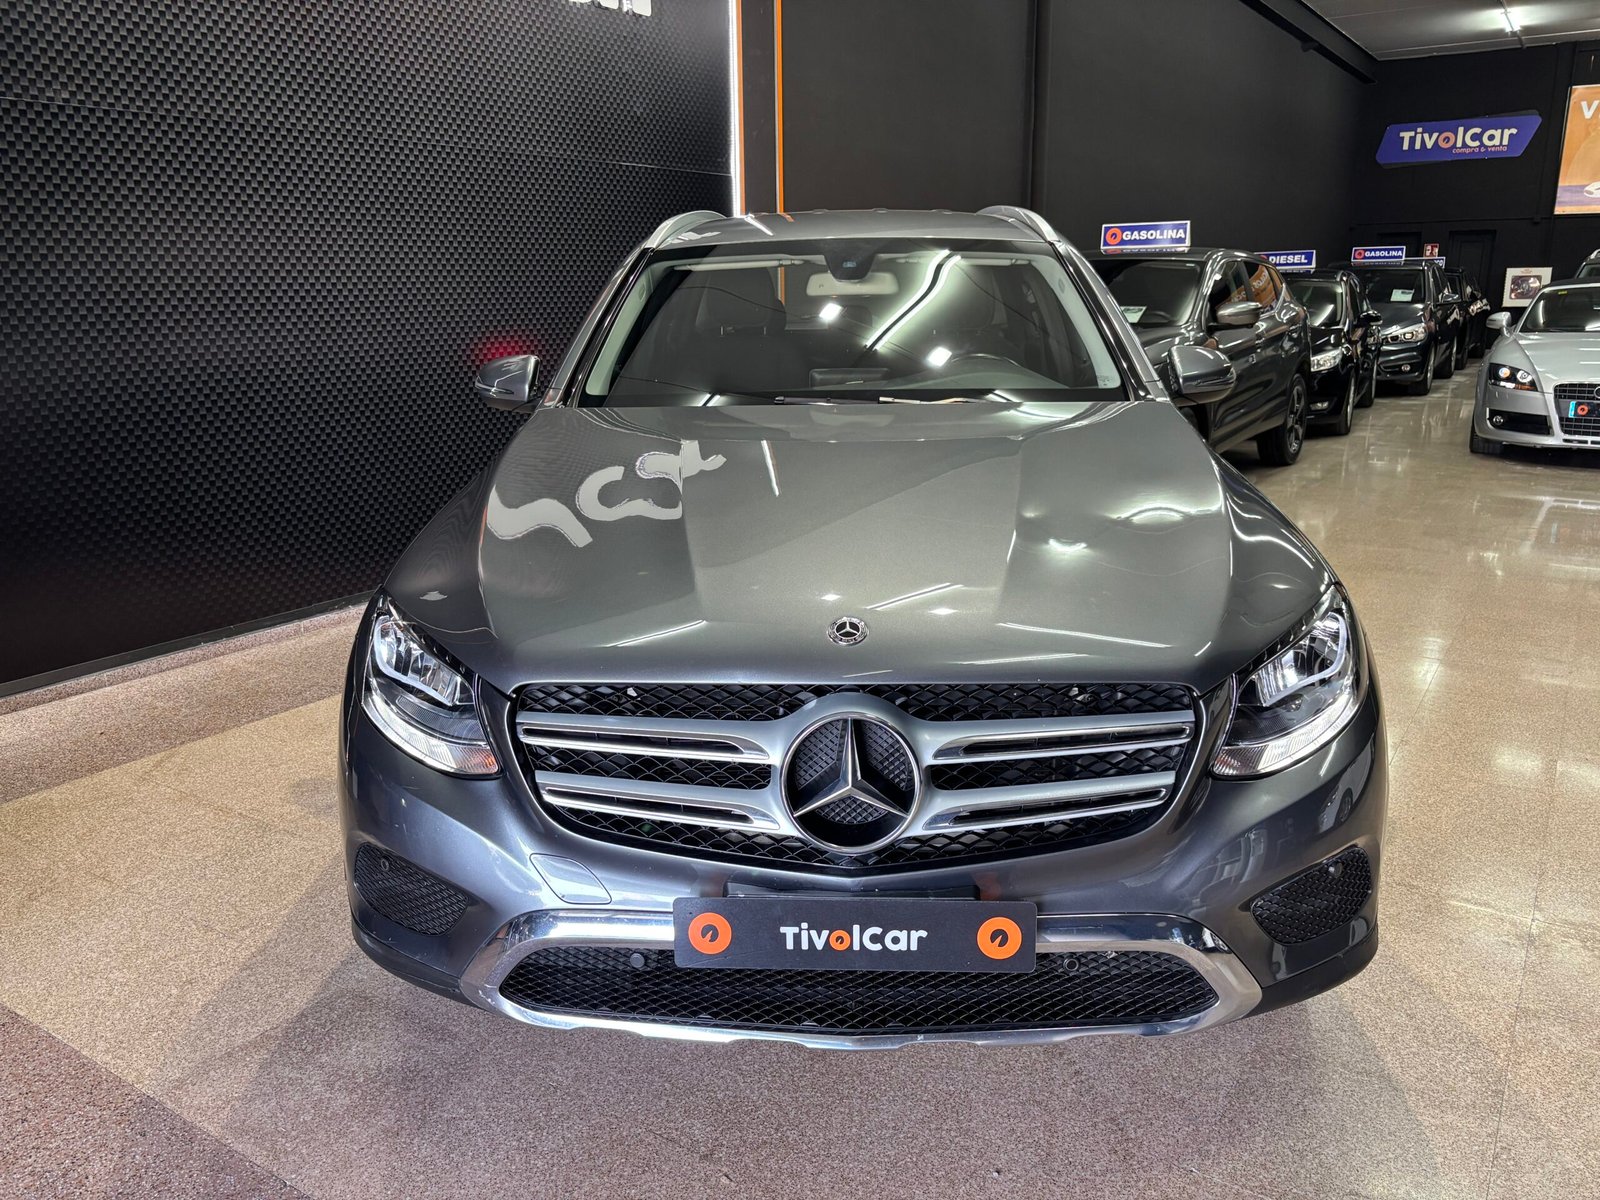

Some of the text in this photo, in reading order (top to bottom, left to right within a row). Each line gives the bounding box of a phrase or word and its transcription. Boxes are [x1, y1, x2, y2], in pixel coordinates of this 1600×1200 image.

[1399, 126, 1518, 151] TivolCar
[1122, 229, 1186, 241] GASOLINA
[1269, 254, 1308, 264] DIESEL
[1364, 250, 1403, 258] GASOLINA
[779, 921, 928, 952] TivolCar
